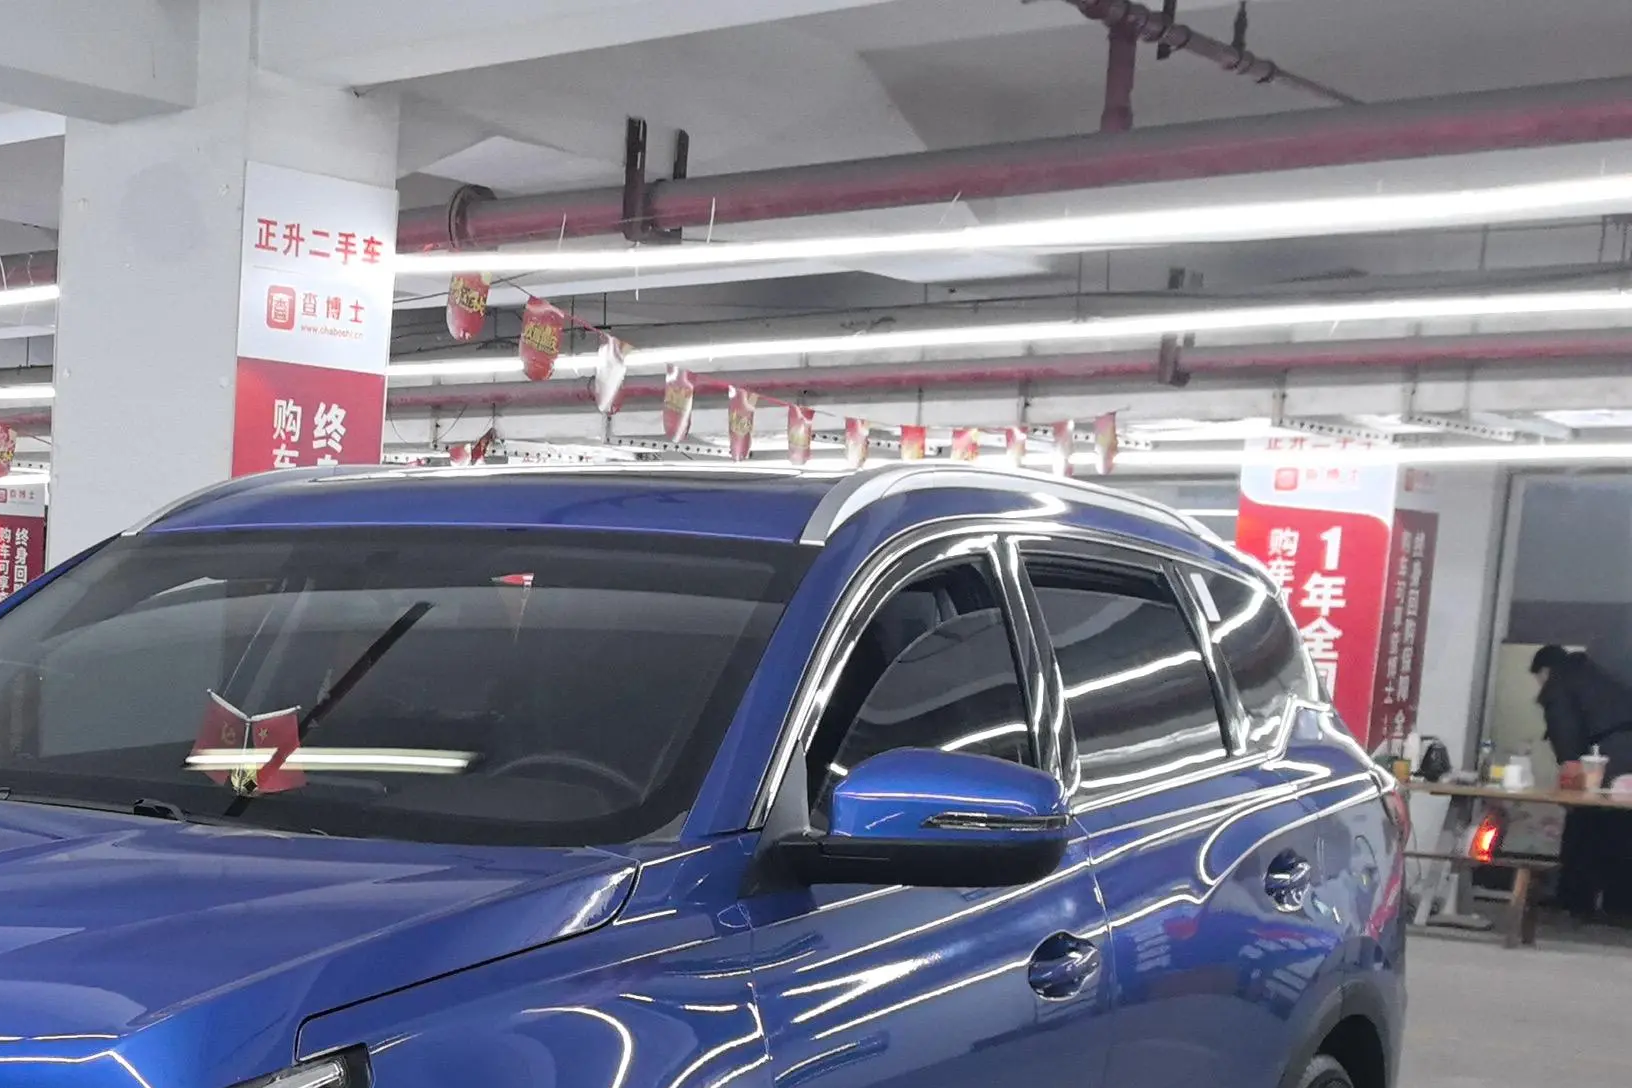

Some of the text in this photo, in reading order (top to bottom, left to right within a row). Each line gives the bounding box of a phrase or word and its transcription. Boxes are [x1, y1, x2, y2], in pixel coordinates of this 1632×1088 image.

[255, 218, 383, 265] 正升二手车
[301, 292, 364, 324] 查博士
[312, 402, 347, 466] 终
